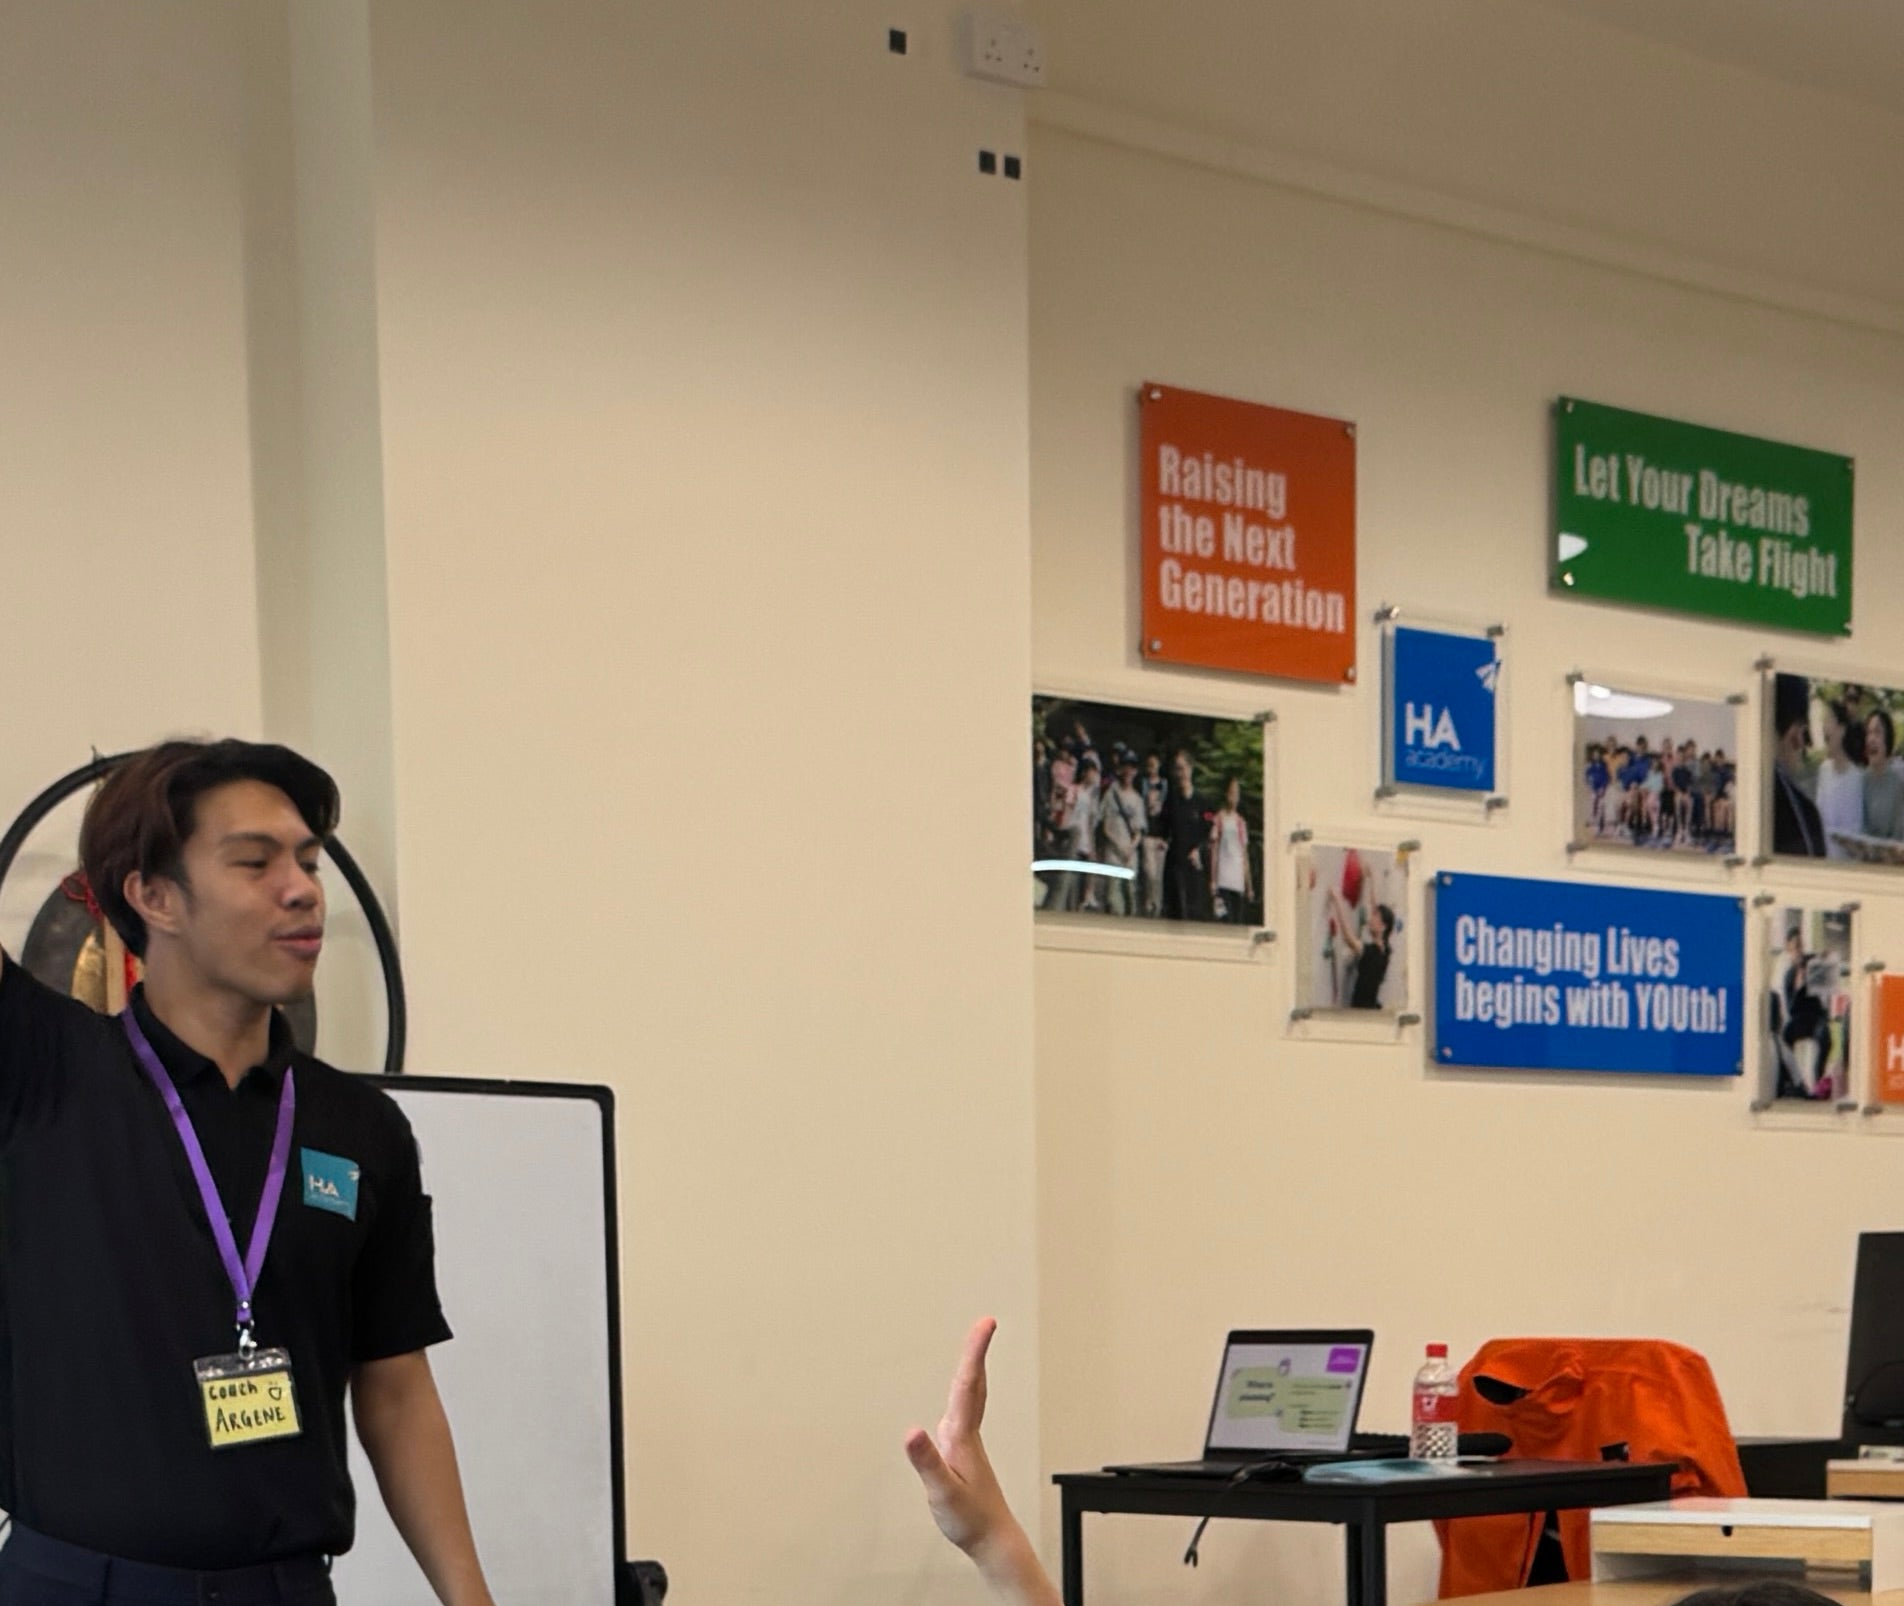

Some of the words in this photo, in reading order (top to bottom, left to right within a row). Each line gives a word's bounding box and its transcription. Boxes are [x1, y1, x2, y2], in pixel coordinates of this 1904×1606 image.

[1159, 444, 1286, 520] Raising
[1575, 443, 1620, 502] Let
[1626, 454, 1693, 516] Your
[1699, 469, 1809, 537] Dreams
[1159, 504, 1215, 558] the
[1223, 512, 1295, 571] Next
[1684, 523, 1753, 583] Take
[1759, 537, 1837, 598] Flight
[1160, 558, 1344, 633] Generation
[1405, 702, 1460, 751] HA
[1456, 914, 1600, 978] Changing
[1607, 926, 1680, 979] Lives
[1456, 971, 1560, 1029] begins
[1566, 981, 1629, 1029] with
[1635, 983, 1727, 1033] YOUth!
[308, 1173, 340, 1198] HA
[216, 1406, 286, 1433] ARGENE
